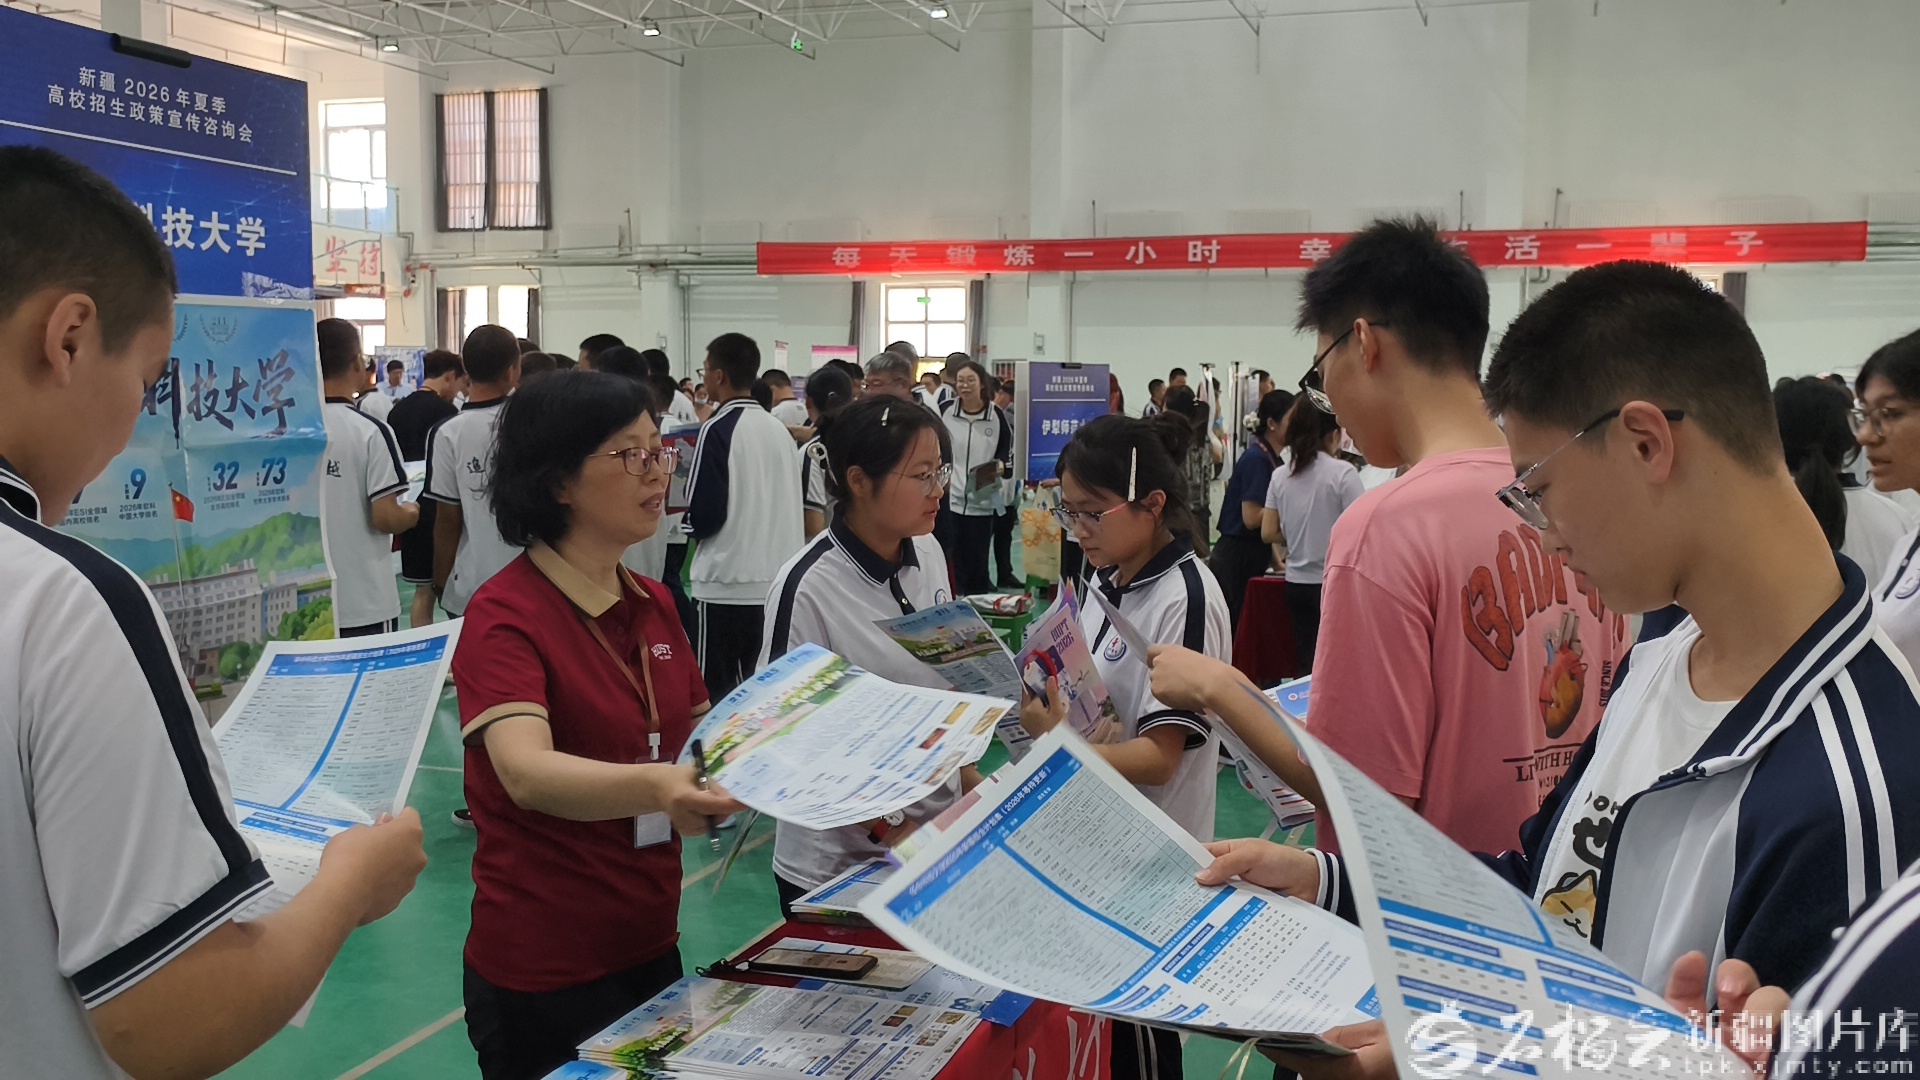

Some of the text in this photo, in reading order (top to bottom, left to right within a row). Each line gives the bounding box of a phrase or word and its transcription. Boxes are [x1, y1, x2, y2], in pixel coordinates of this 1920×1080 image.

[47, 84, 253, 143] 高校招生政策宣传咨询会
[1299, 230, 1763, 263] 幸活一辈子
[1042, 419, 1086, 436] 伊犁师范
[130, 468, 147, 500] 9
[212, 460, 240, 491] 32
[261, 457, 288, 486] 73
